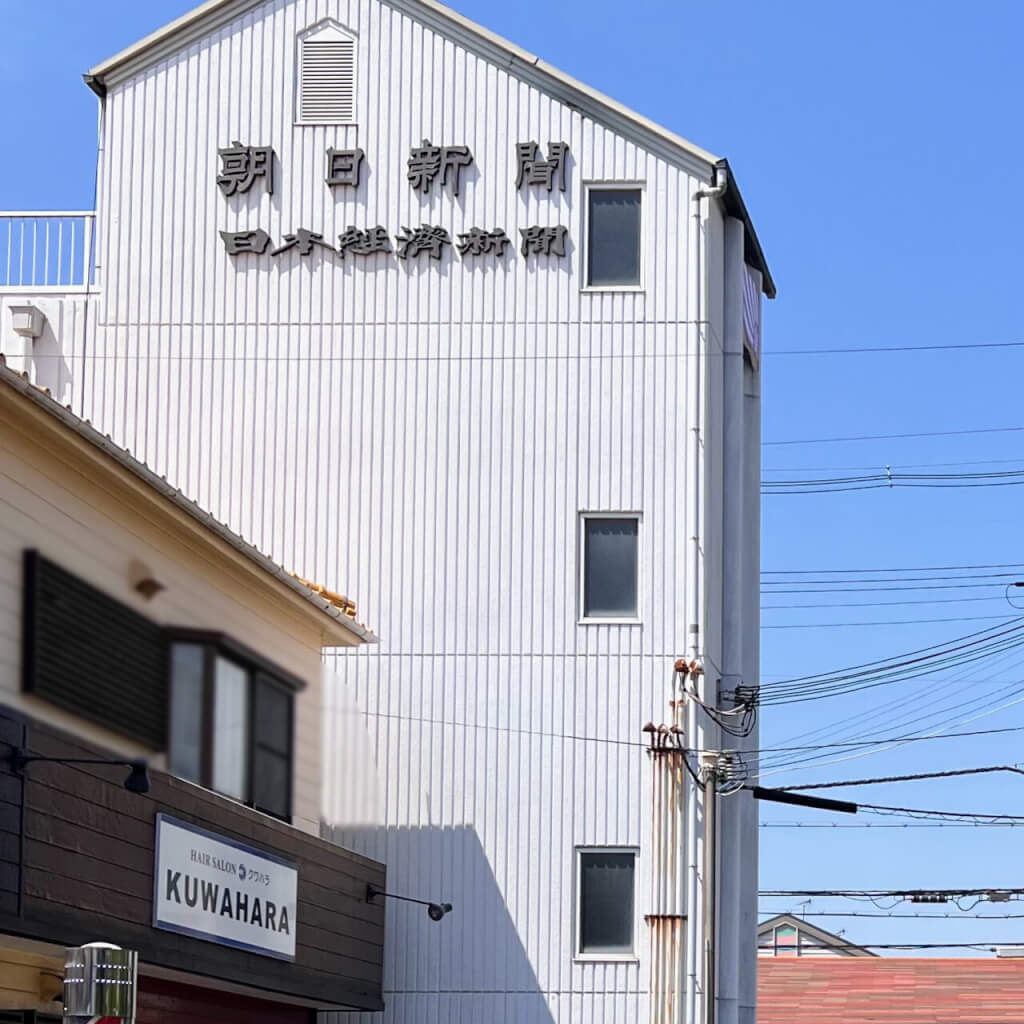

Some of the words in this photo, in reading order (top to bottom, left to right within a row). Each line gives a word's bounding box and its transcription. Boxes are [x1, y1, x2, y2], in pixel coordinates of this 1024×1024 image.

[217, 140, 569, 196] 朝日新聞
[190, 848, 210, 866] HAIR
[211, 857, 237, 875] SALON
[166, 868, 290, 935] KUWAHARA
